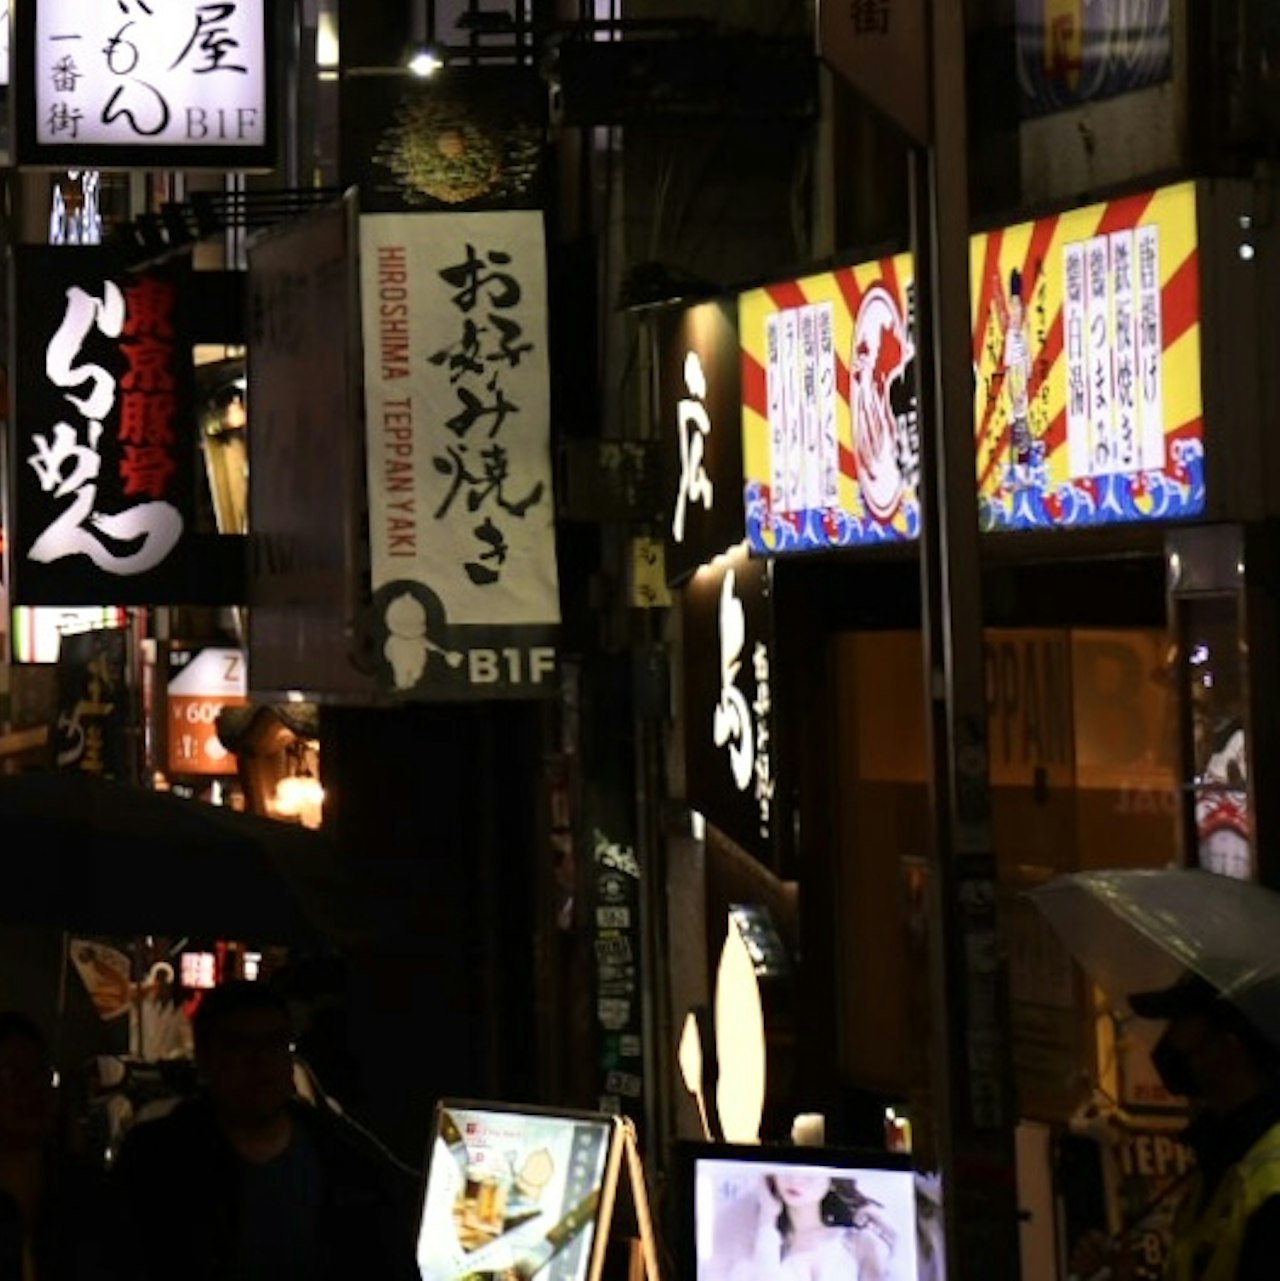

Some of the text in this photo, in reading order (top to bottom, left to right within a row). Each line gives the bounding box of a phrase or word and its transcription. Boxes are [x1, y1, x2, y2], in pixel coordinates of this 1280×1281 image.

[49, 33, 84, 139] 一番街
[185, 108, 258, 139] B1F
[377, 246, 412, 380] HIROSHIMA
[429, 245, 545, 585] お好み焼き
[467, 648, 555, 685] B1F
